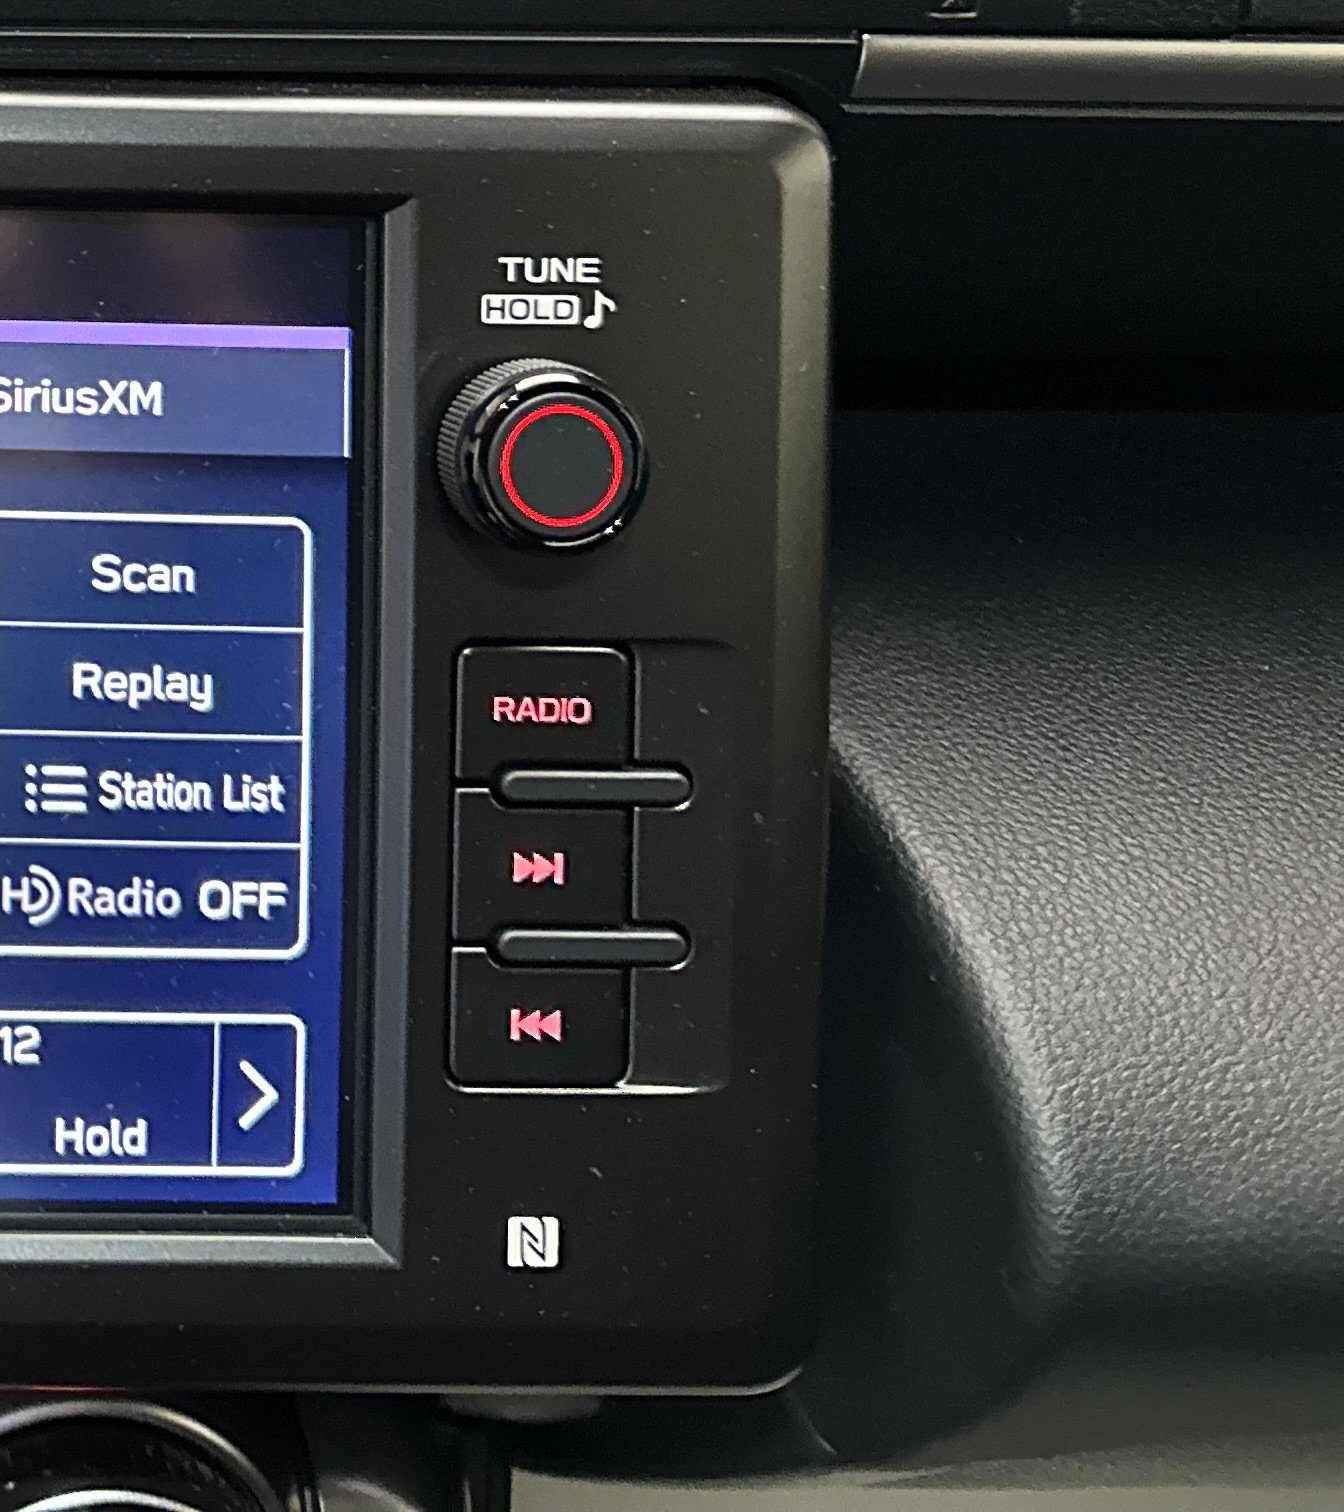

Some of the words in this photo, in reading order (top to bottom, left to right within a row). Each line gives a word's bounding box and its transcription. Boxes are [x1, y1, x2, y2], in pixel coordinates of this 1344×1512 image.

[498, 257, 602, 284] TUNE
[485, 298, 576, 321] HOLD
[91, 553, 196, 594] Scan
[72, 662, 214, 712] Replay
[493, 696, 593, 725] RADIO
[99, 770, 212, 812] Station
[223, 773, 286, 813] List
[68, 877, 181, 918] Radio
[199, 881, 289, 920] OFF
[54, 1118, 149, 1158] Hold
